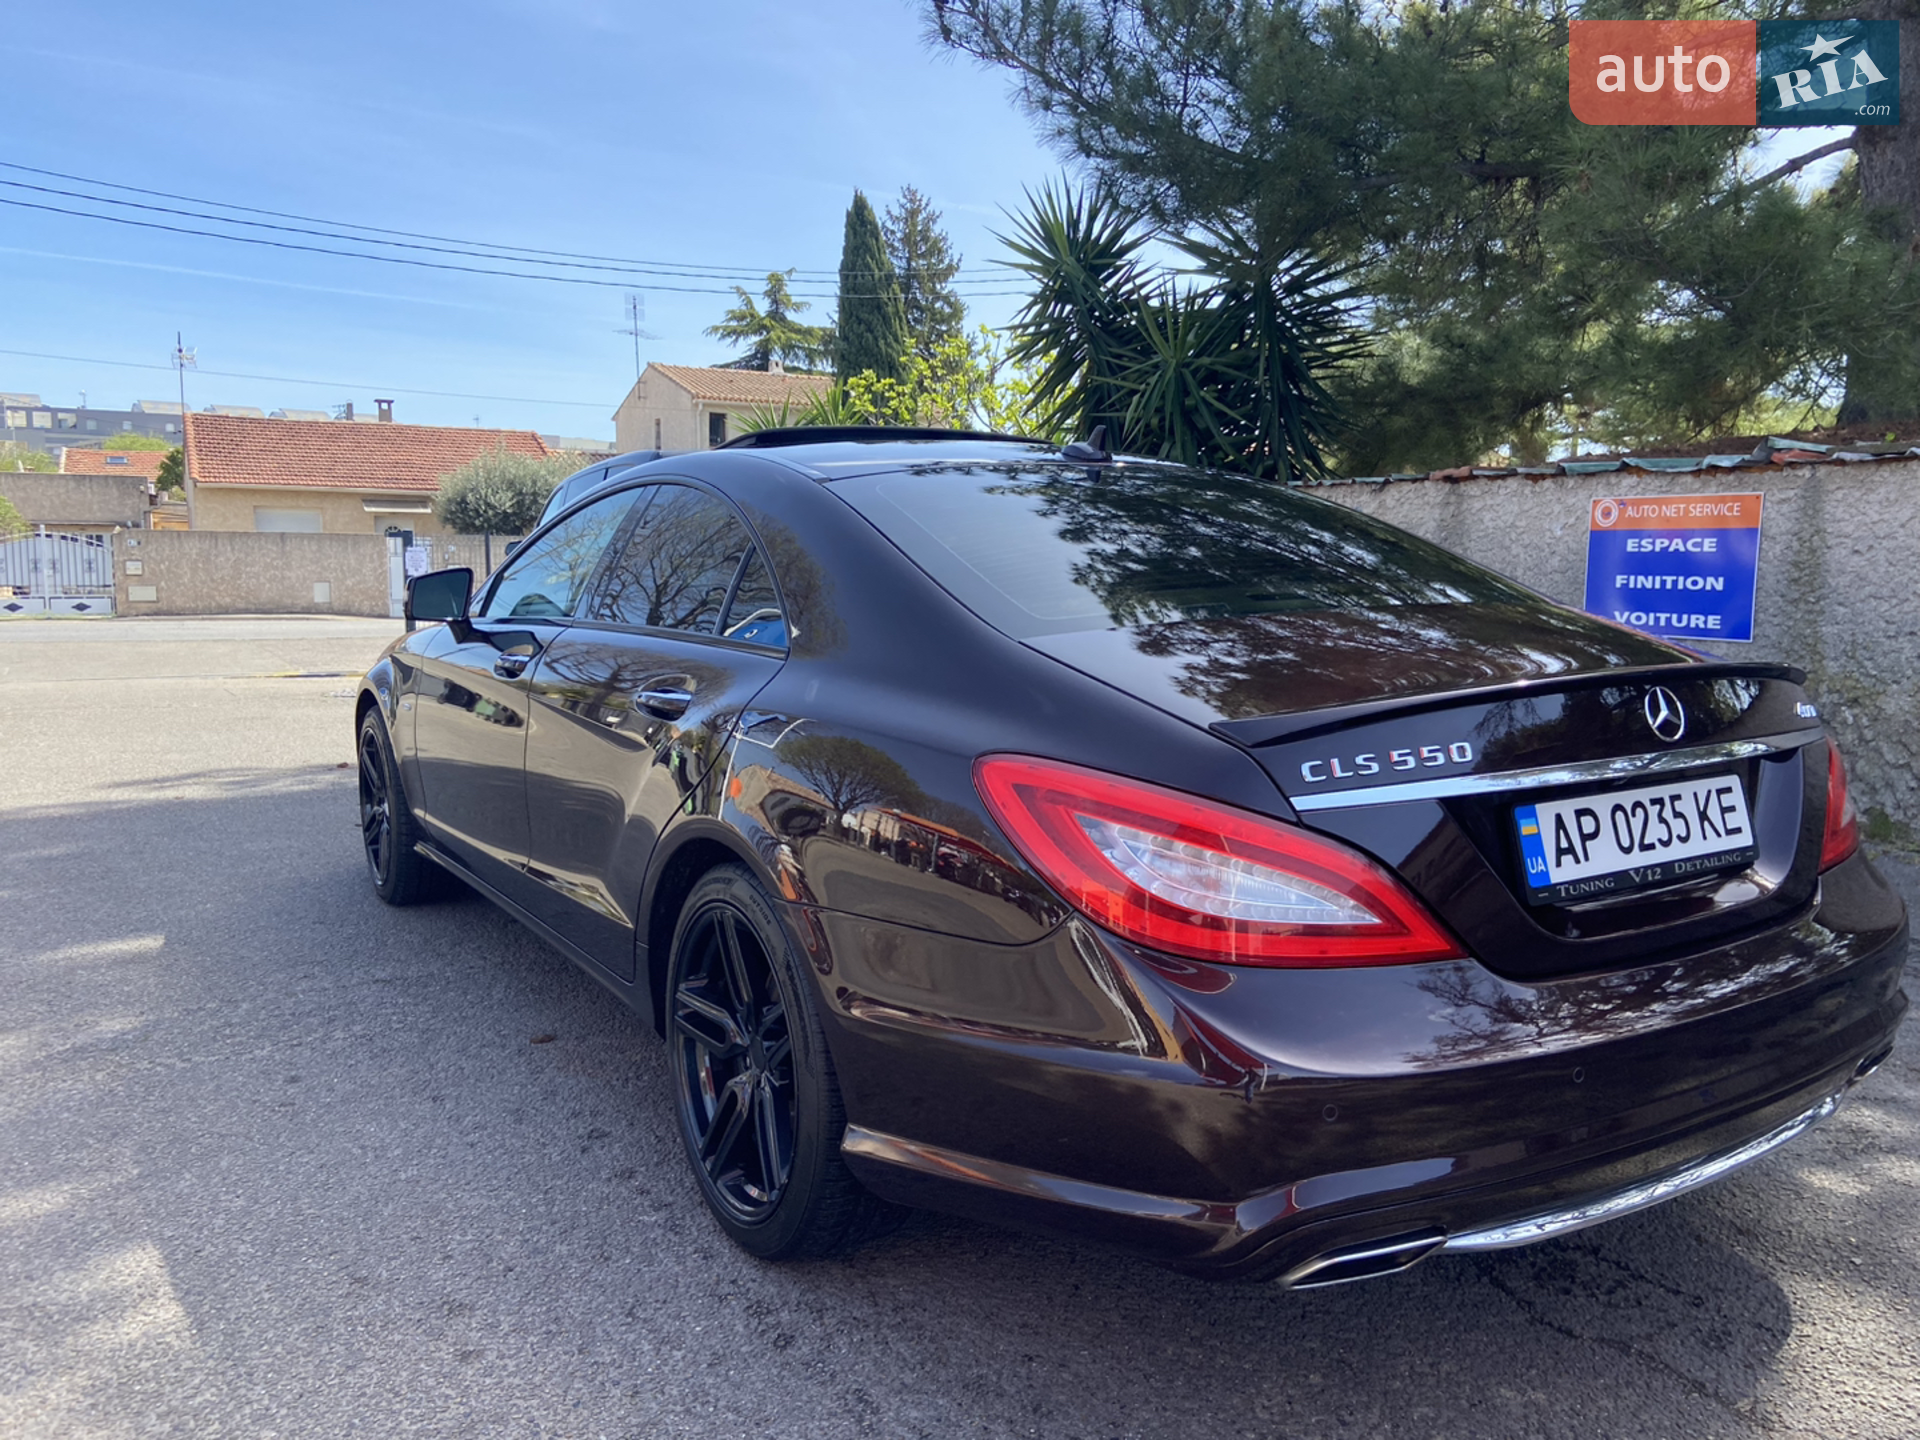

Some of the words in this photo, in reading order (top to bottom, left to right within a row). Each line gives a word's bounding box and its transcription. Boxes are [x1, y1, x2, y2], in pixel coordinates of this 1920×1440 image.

[1625, 505, 1659, 518] AUTO
[1661, 504, 1686, 517] NET
[1688, 502, 1742, 517] SERVICE
[1626, 538, 1717, 552] ESPACE
[1615, 575, 1724, 591] FINITION
[1614, 611, 1721, 629] VOITURE
[1301, 753, 1380, 783] CLS
[1389, 741, 1473, 770] 550
[1554, 807, 1601, 868] AP
[1611, 793, 1692, 855] 0235
[1693, 786, 1743, 841] KE
[1527, 856, 1546, 875] UA
[1628, 867, 1662, 884] V12
